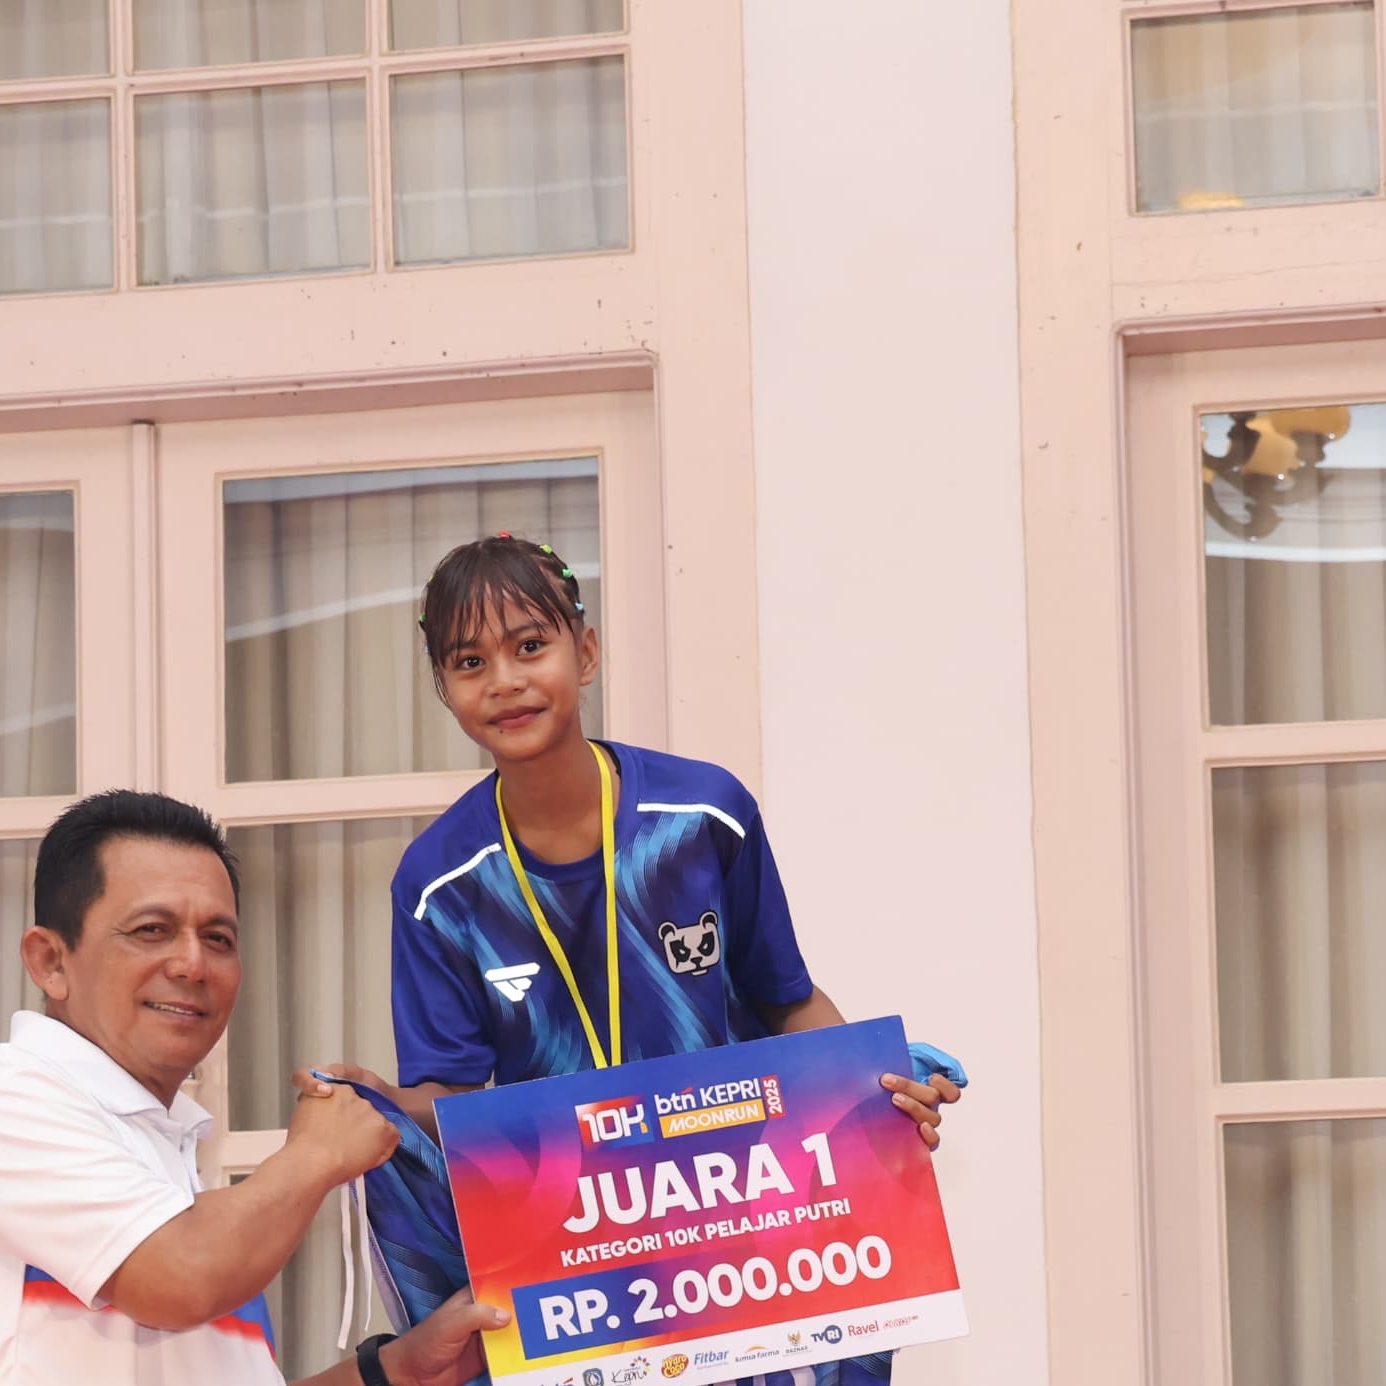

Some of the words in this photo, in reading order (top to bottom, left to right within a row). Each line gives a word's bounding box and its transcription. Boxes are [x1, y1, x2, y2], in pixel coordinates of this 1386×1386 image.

[654, 1087, 695, 1114] btn
[699, 1077, 761, 1106] KEPRI
[763, 1078, 783, 1114] 2025
[668, 1103, 760, 1133] MOONRUN
[563, 1143, 796, 1234] JUARA
[801, 1132, 837, 1187] 1
[561, 1233, 663, 1267] KATEGORI
[665, 1228, 702, 1248] 10K
[705, 1205, 792, 1241] PELAJAR
[795, 1198, 852, 1227] PUTRI
[539, 1288, 620, 1341] RP.
[627, 1235, 892, 1324] 2.000.000
[847, 1320, 880, 1337] Ravel
[693, 1350, 730, 1365] Fitbar
